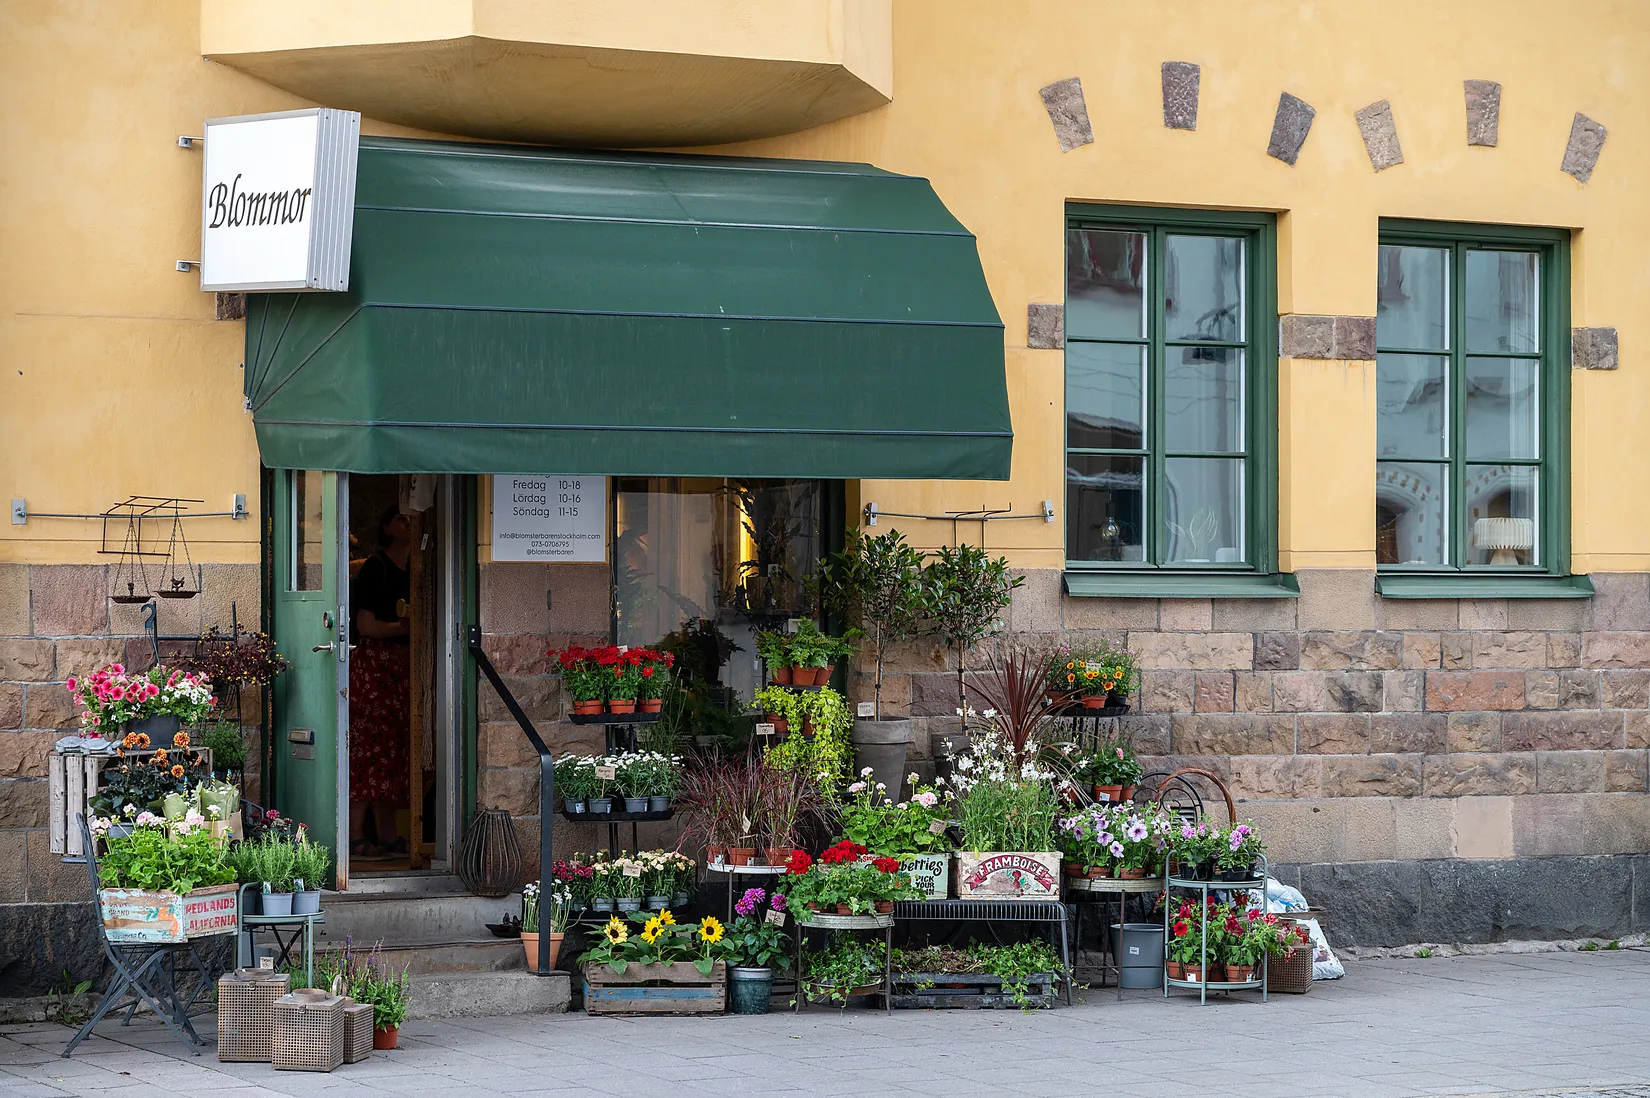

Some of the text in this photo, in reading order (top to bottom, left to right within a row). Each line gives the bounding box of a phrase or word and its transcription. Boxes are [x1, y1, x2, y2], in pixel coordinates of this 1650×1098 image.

[209, 173, 312, 228] Blommor
[513, 480, 581, 491] Fredag 10-18
[513, 493, 581, 505] Lördag 10-16
[513, 506, 578, 518] Söndag 11-15
[979, 856, 1047, 876] FRAMBOISE
[915, 881, 935, 889] YOUR
